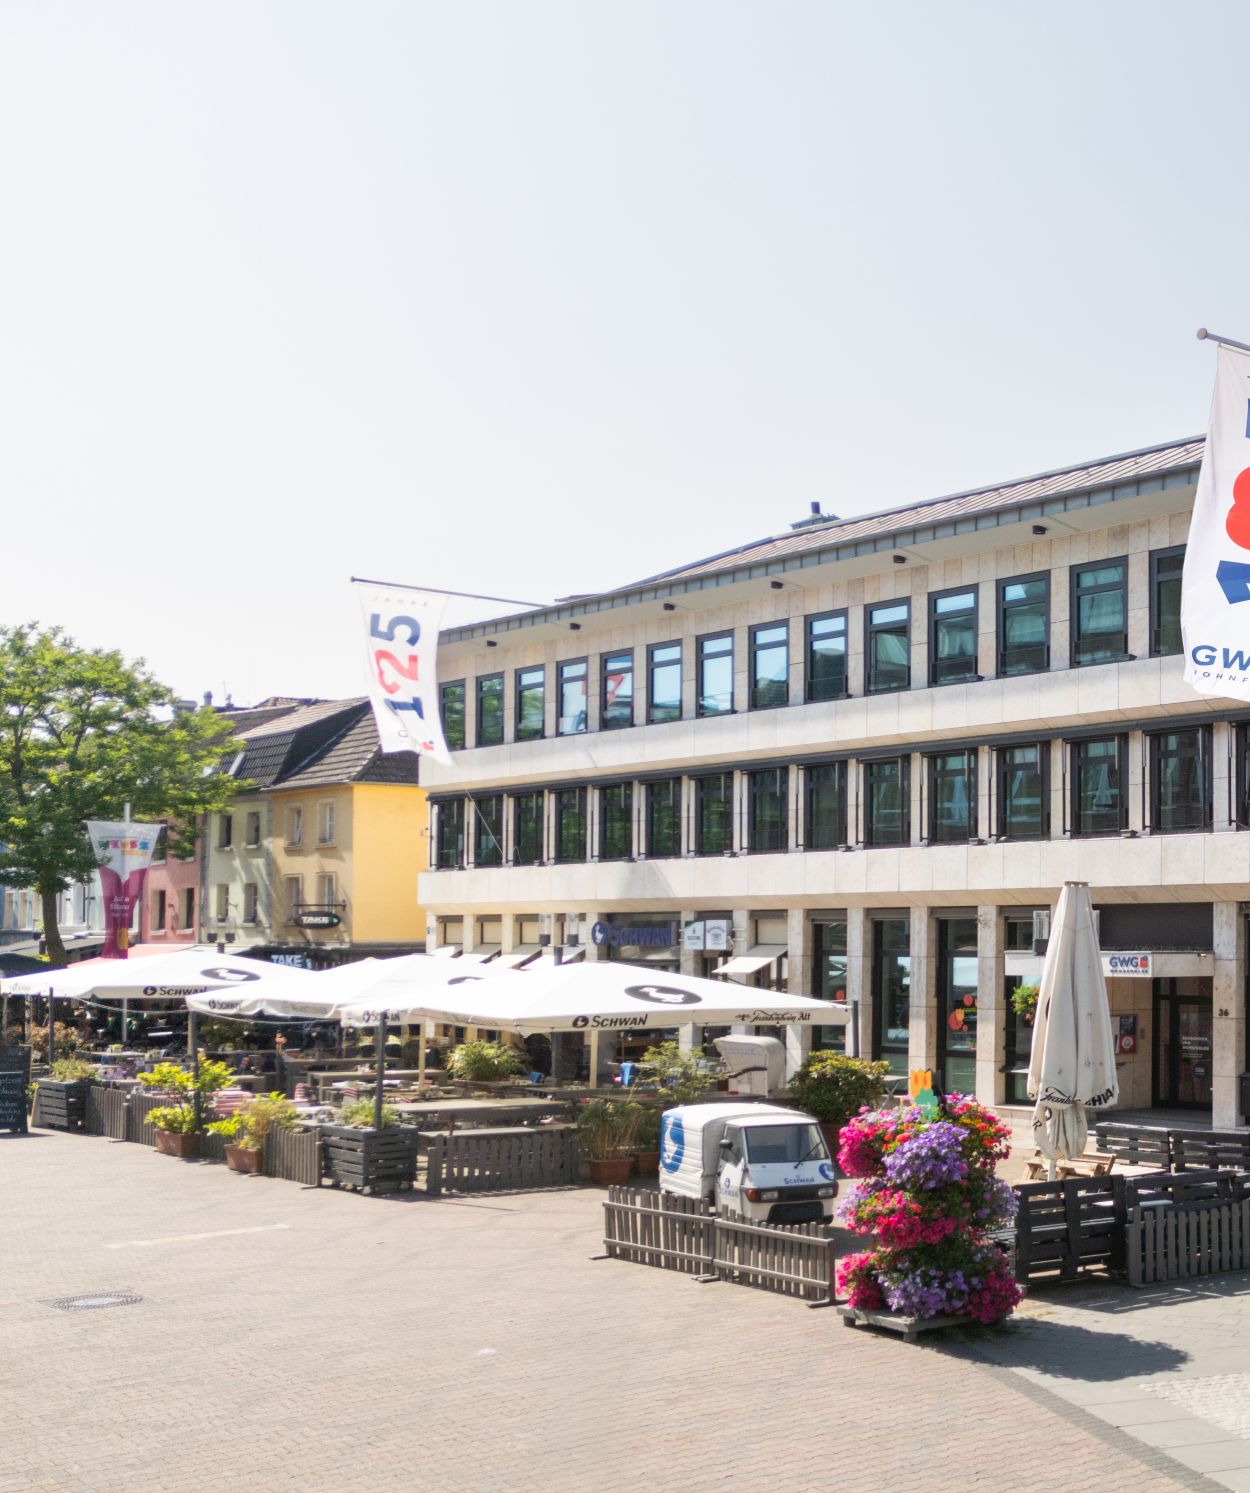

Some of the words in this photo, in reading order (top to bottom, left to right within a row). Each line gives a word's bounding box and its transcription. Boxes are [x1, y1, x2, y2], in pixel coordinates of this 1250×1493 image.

[271, 954, 302, 968] TAKE
[1109, 956, 1139, 968] GWG
[1218, 1009, 1229, 1017] 36
[591, 1013, 649, 1028] SCHWAN
